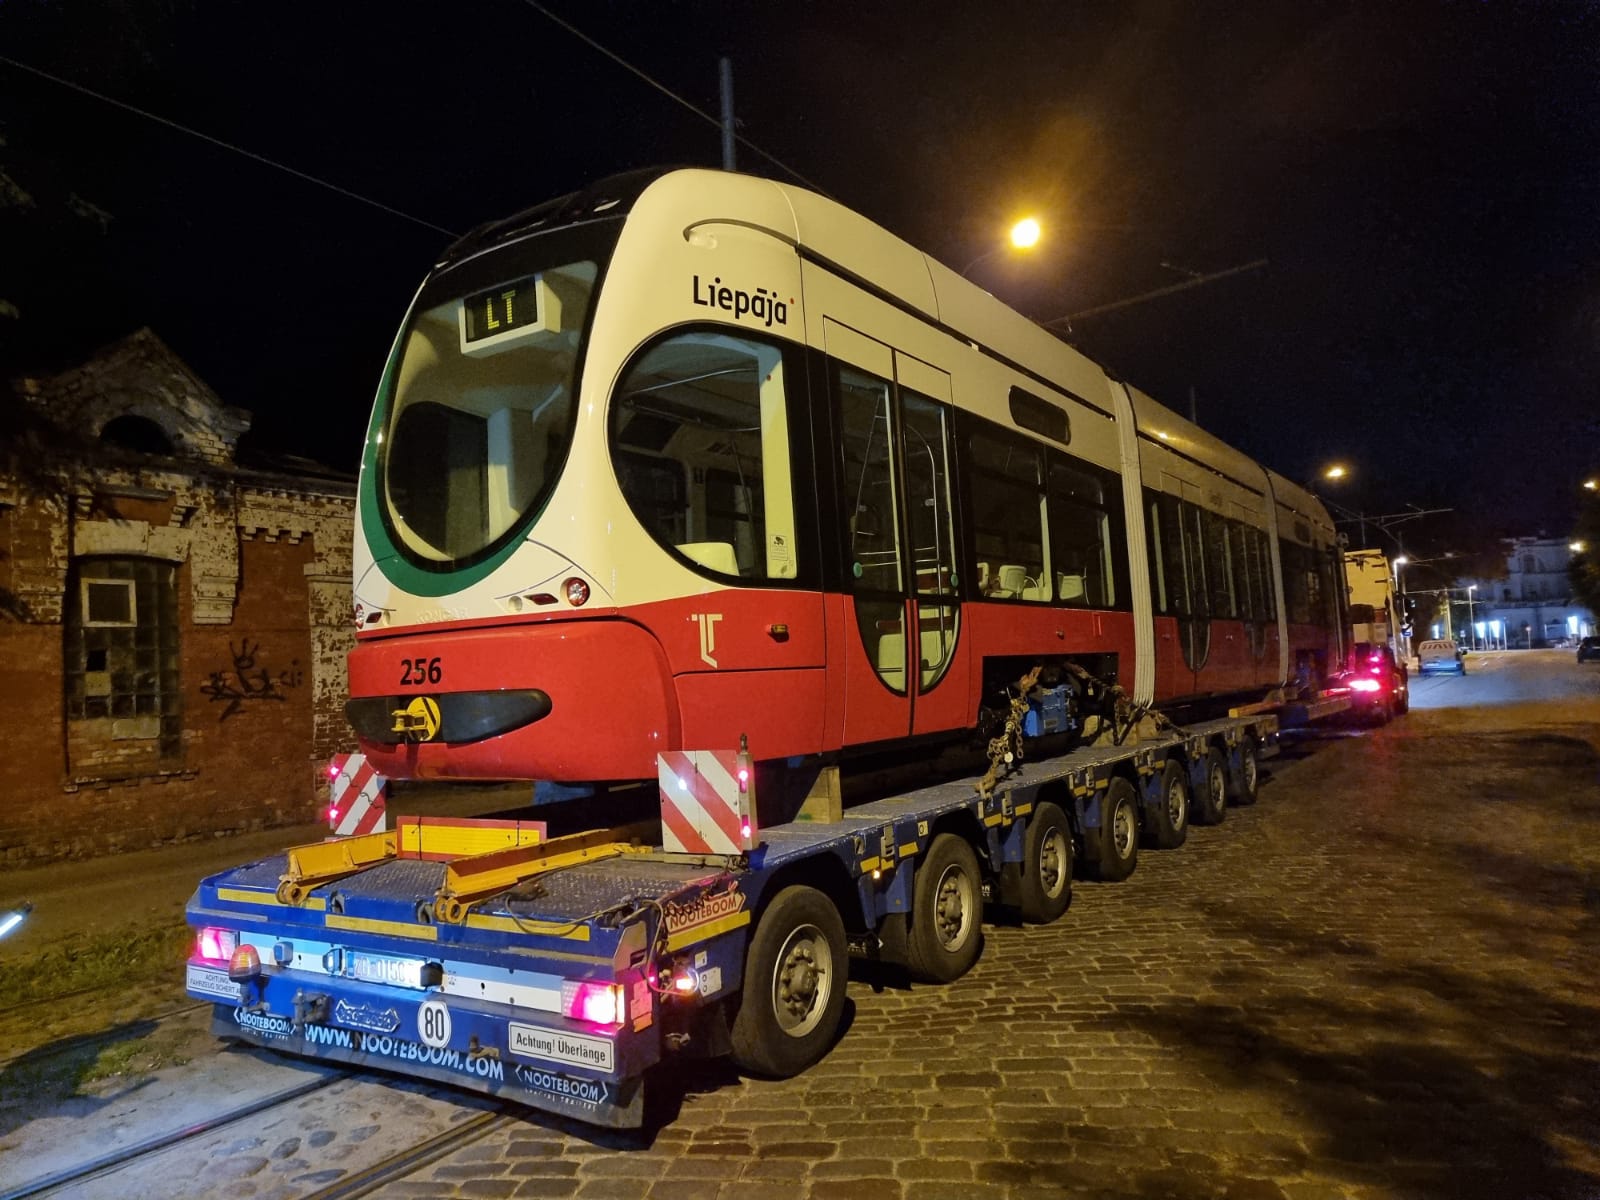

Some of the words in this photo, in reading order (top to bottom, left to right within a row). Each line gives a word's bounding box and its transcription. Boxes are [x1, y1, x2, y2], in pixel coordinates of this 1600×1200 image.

[486, 290, 516, 330] LT
[693, 275, 787, 327] Liepāja
[400, 657, 442, 686] 256
[669, 898, 738, 930] NOOTEBOOM
[240, 1011, 290, 1033] NOOTEBOOM
[424, 1006, 445, 1042] 80
[516, 1032, 556, 1054] Achtung!
[558, 1037, 606, 1064] Überlänge
[524, 1069, 599, 1101] NOOTEBOOM
